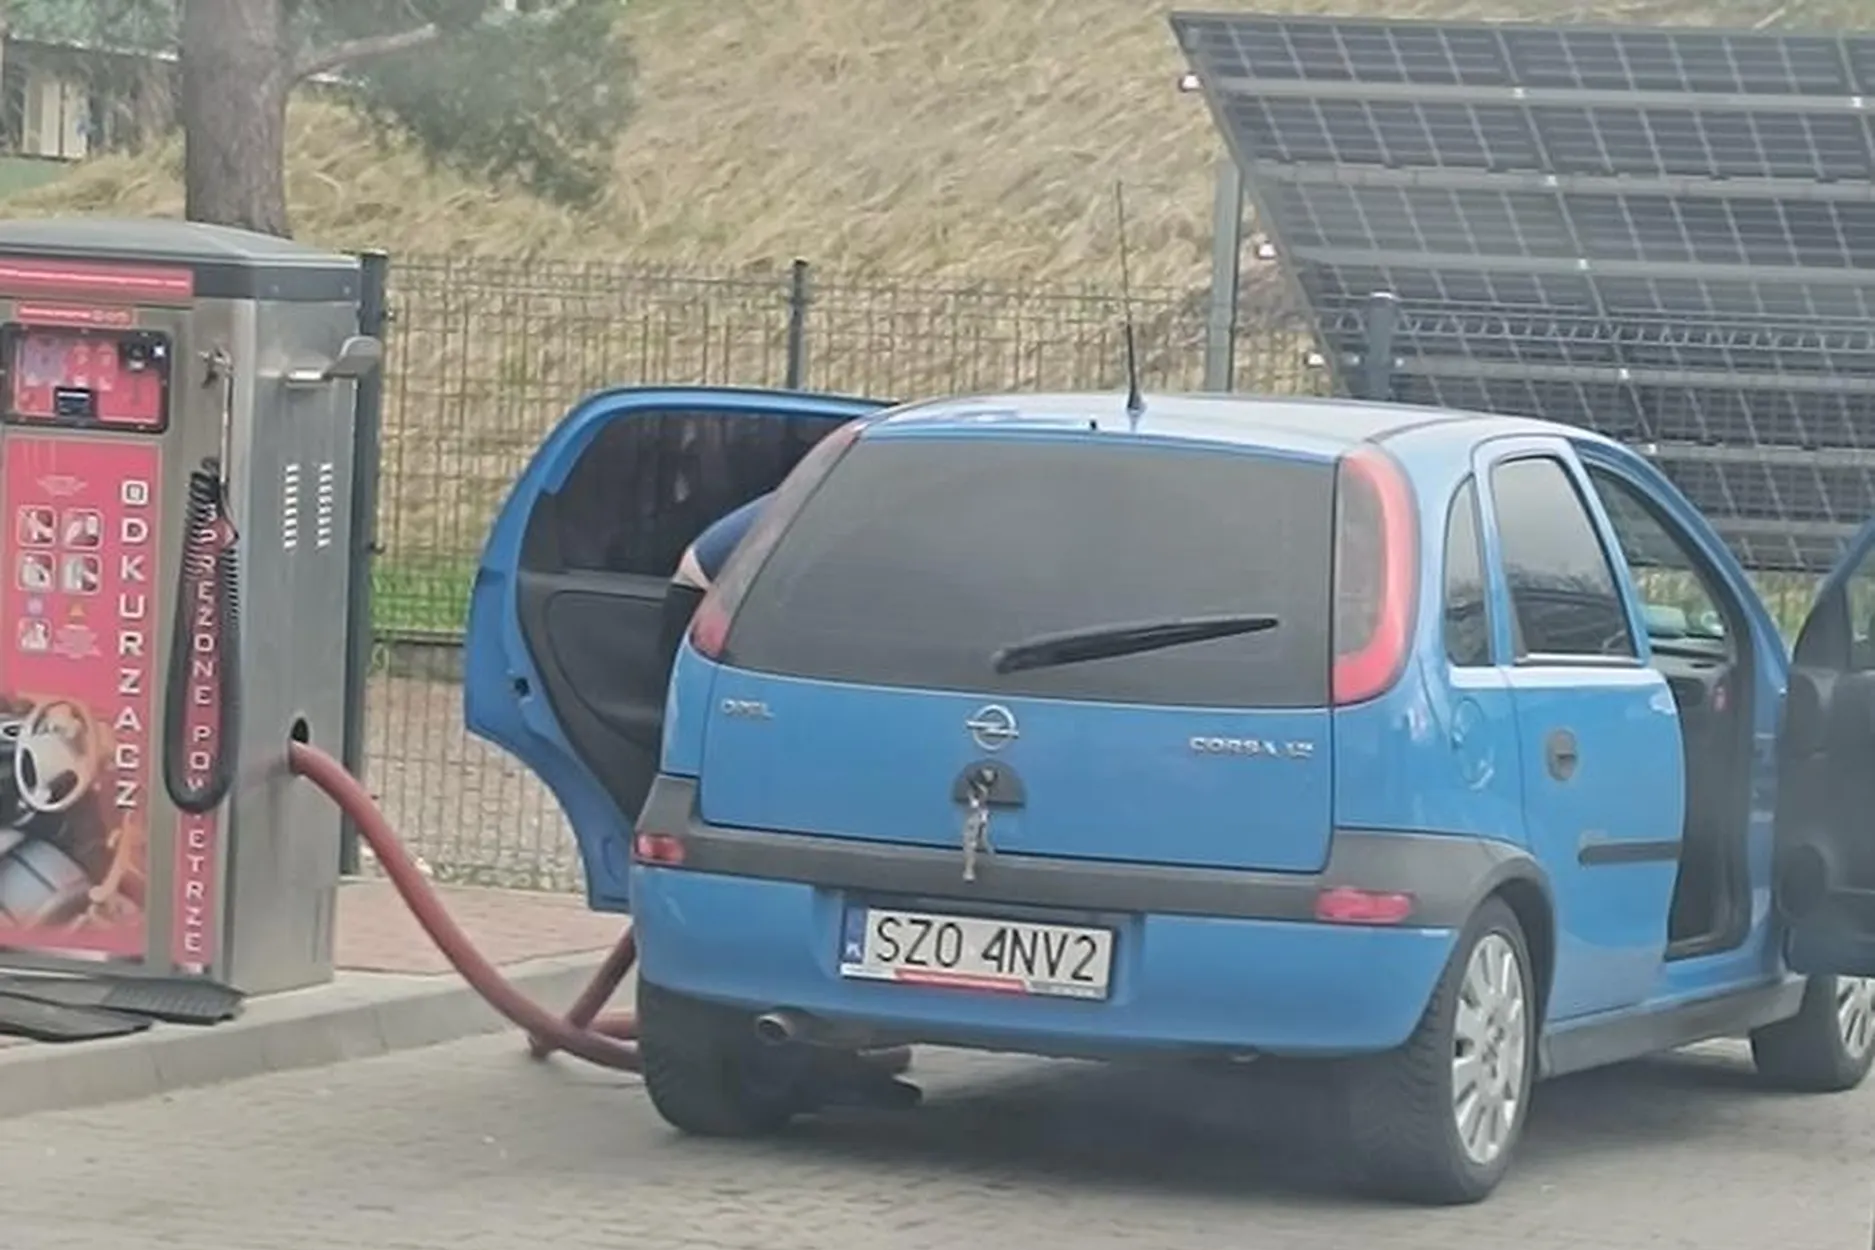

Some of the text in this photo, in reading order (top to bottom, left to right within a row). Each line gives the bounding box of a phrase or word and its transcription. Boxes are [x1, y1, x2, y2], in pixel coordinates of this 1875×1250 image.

[113, 480, 148, 807] ODKURZACZ
[184, 725, 211, 951] POWETRZE
[876, 917, 963, 968] SZO
[981, 927, 1098, 982] 4NV2
